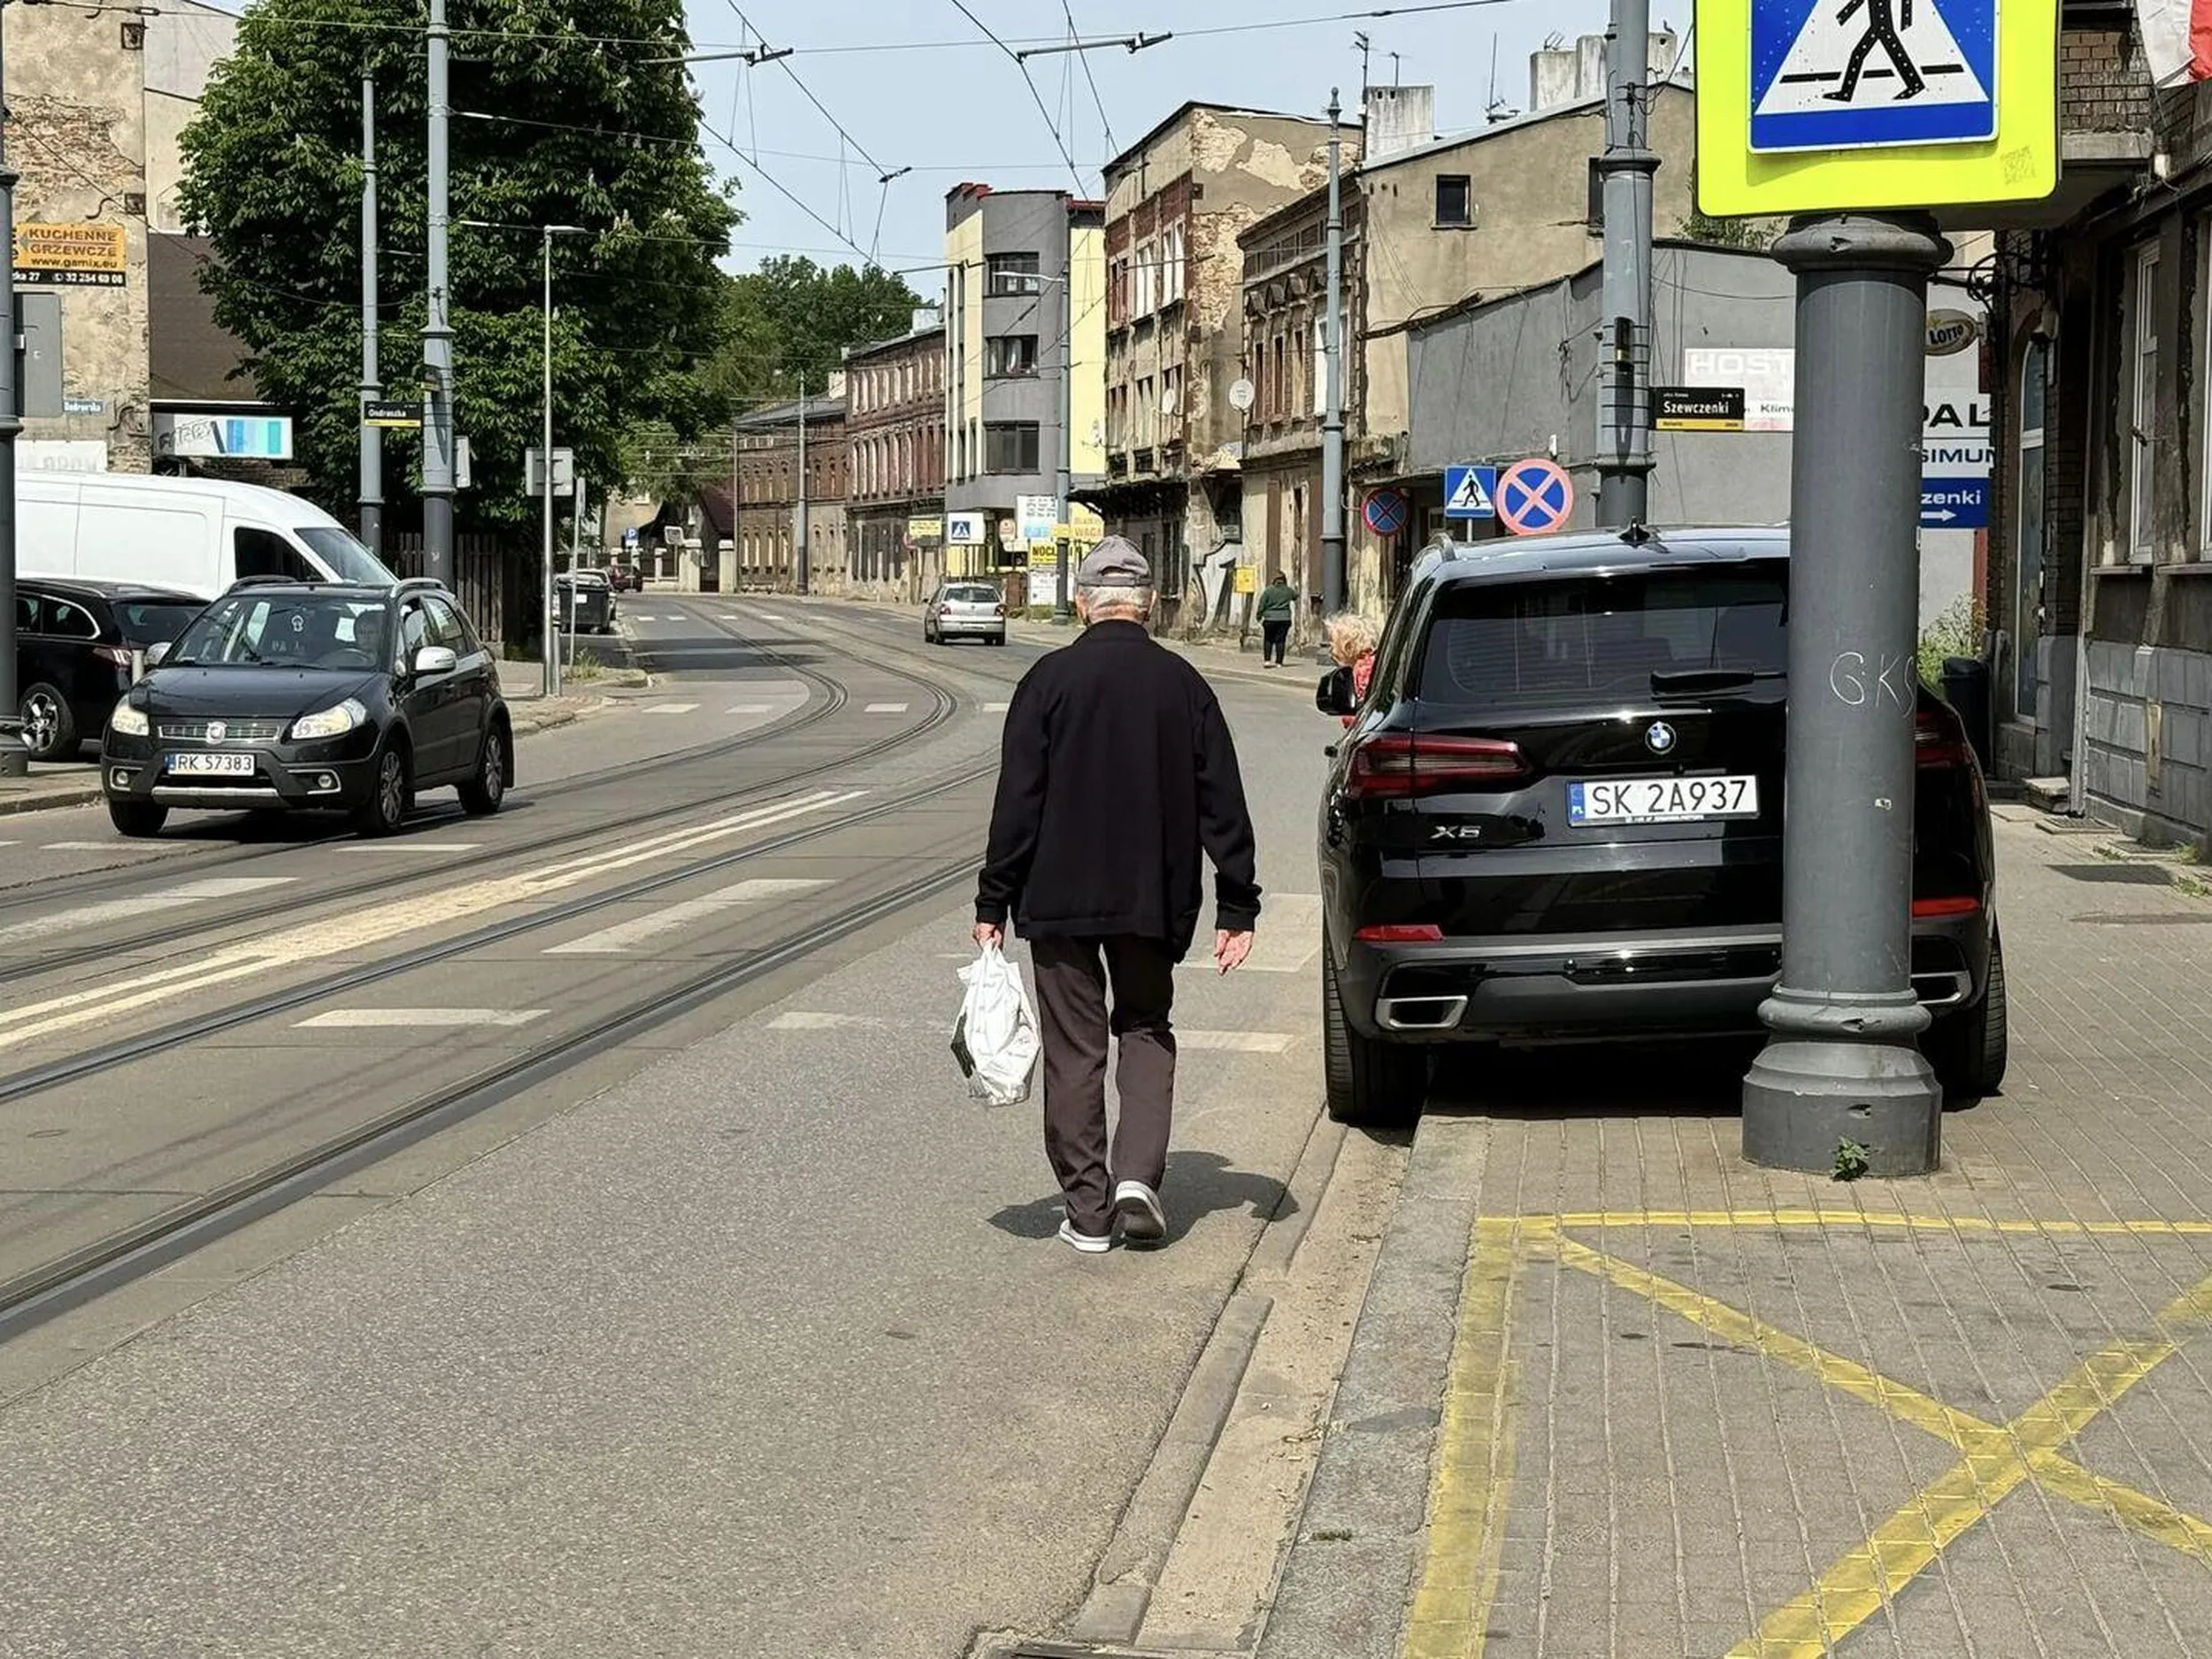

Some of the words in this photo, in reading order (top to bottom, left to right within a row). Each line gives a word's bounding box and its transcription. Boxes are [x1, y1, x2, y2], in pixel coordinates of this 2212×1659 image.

[29, 228, 117, 242] KUCHENNE
[30, 243, 117, 257] GRZEWCZE
[1929, 324, 1963, 344] LOTTO
[1663, 401, 1729, 413] Szewczenki
[178, 756, 199, 770] RK
[205, 756, 251, 771] 57383
[1593, 785, 1632, 815] SK
[1647, 780, 1747, 813] 2A937
